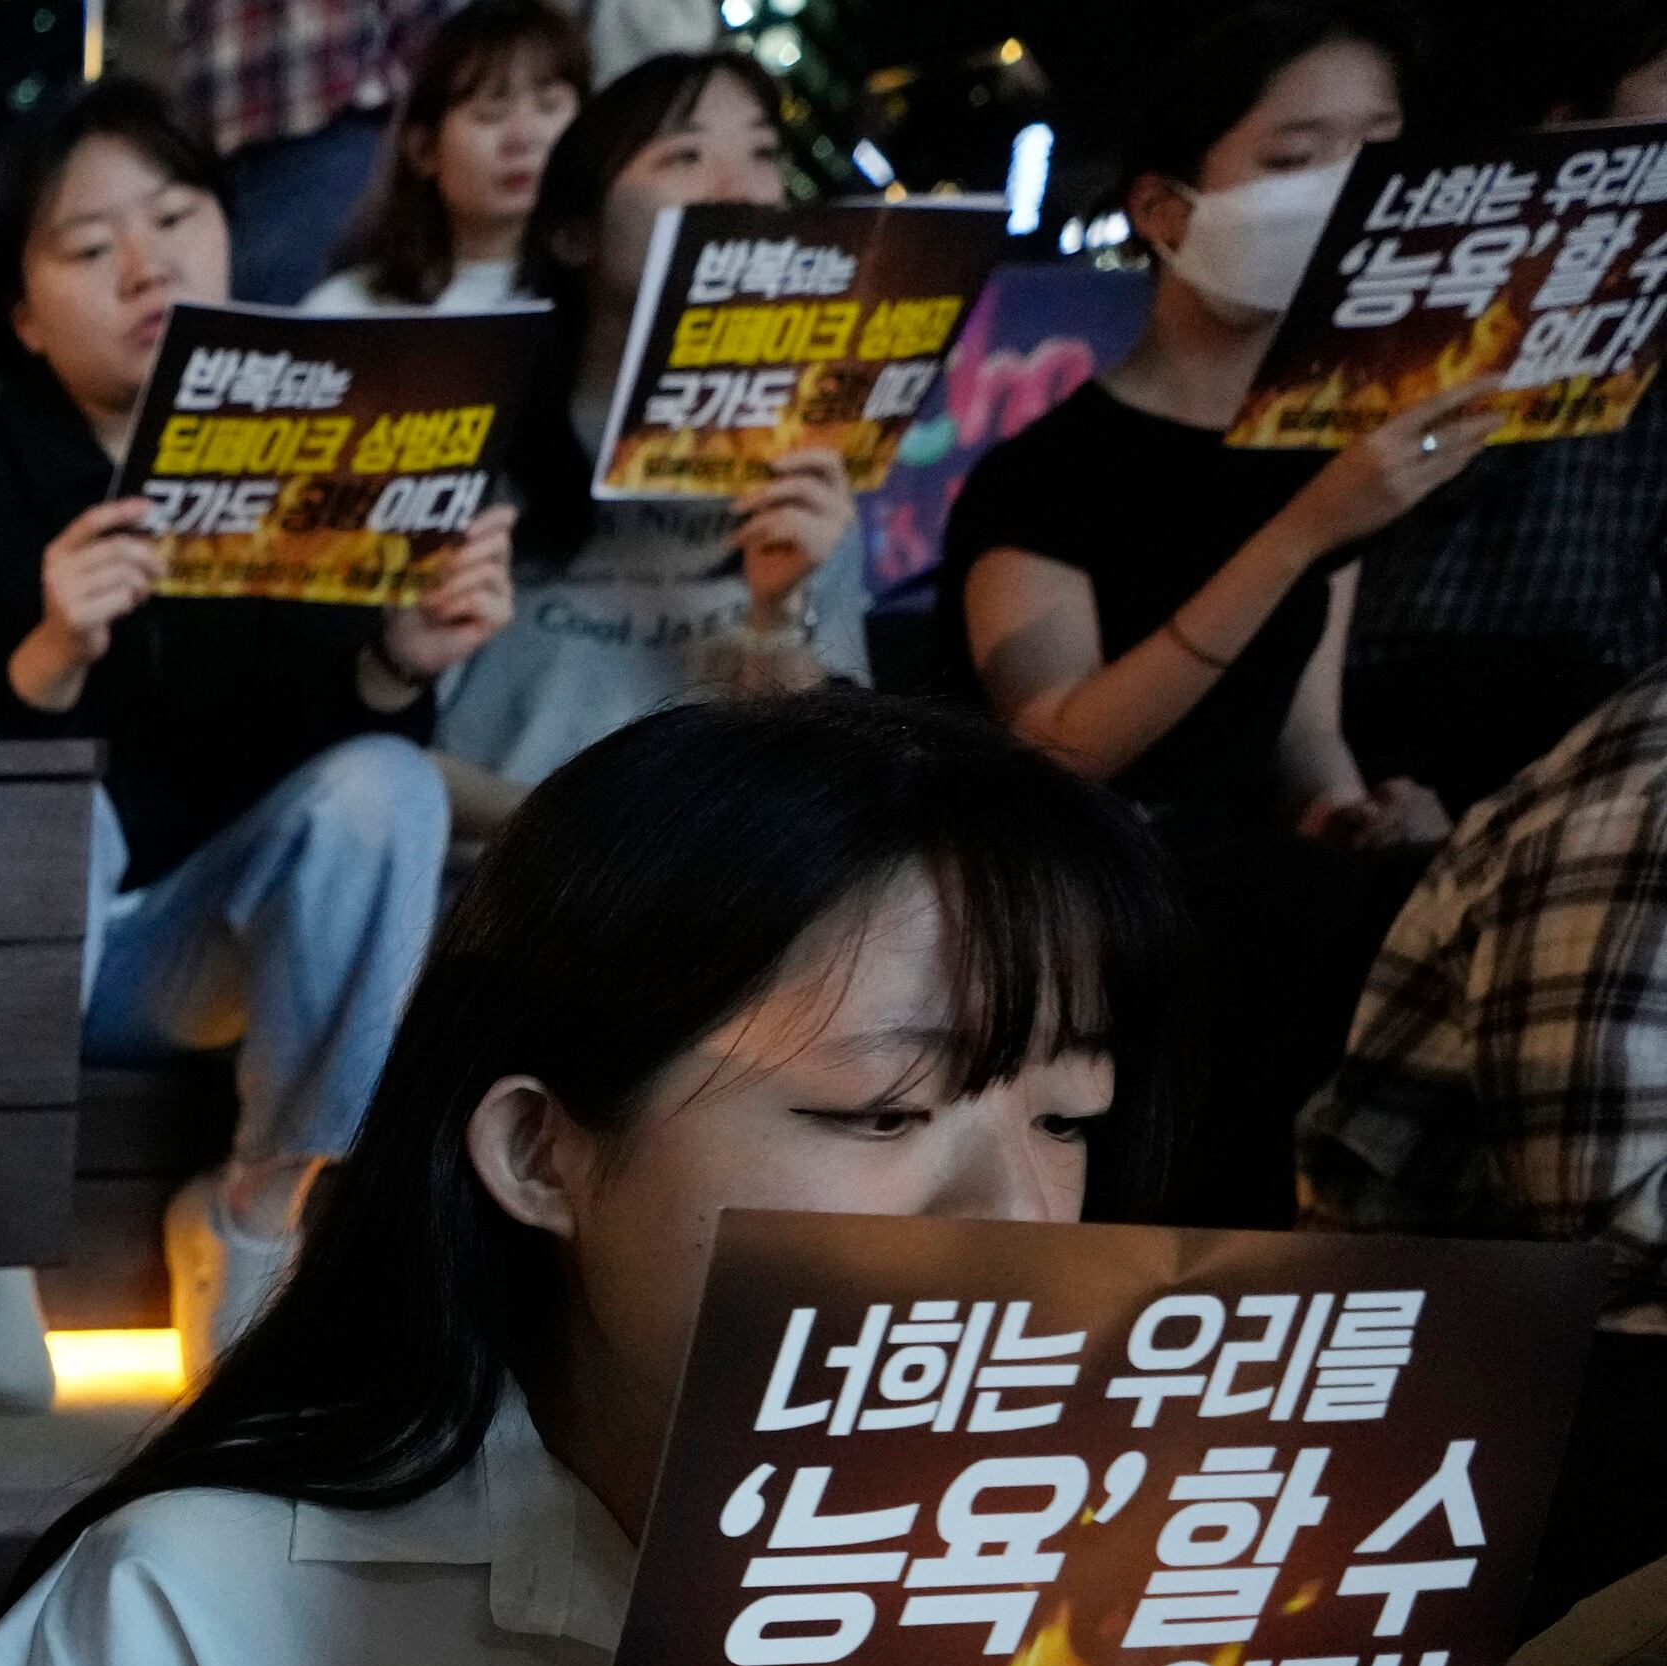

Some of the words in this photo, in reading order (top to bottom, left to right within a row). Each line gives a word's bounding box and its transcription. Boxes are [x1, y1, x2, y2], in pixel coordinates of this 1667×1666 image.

[1363, 163, 1538, 232] 너희는
[644, 369, 797, 430] 국가도
[141, 479, 280, 537] 국가도
[753, 1299, 1087, 1436] 너희는
[1105, 1288, 1427, 1427] 우리를
[1335, 1438, 1487, 1638] 수
